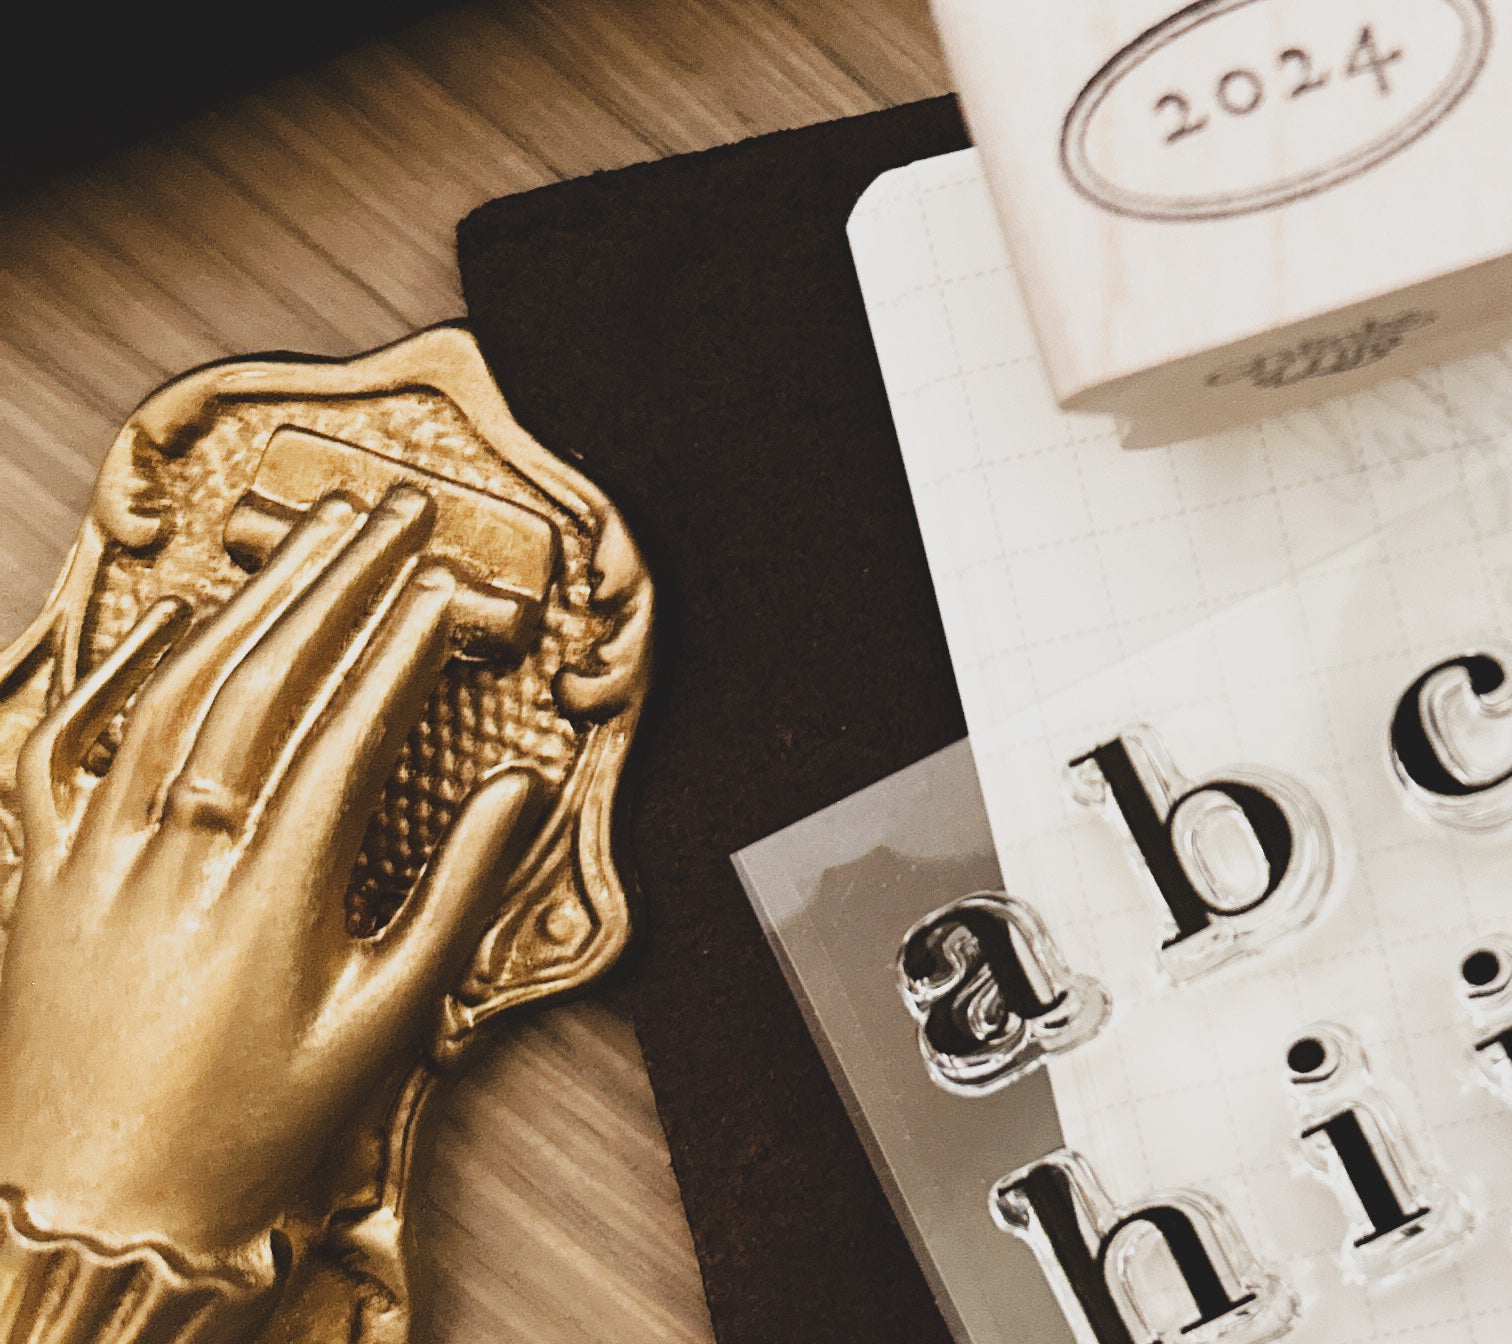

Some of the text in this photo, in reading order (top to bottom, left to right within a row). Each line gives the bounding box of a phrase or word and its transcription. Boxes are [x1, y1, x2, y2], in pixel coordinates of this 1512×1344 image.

[1153, 24, 1403, 147] 2024
[903, 900, 1072, 1061] a
[1067, 736, 1294, 952] b
[1286, 1038, 1431, 1249] i
